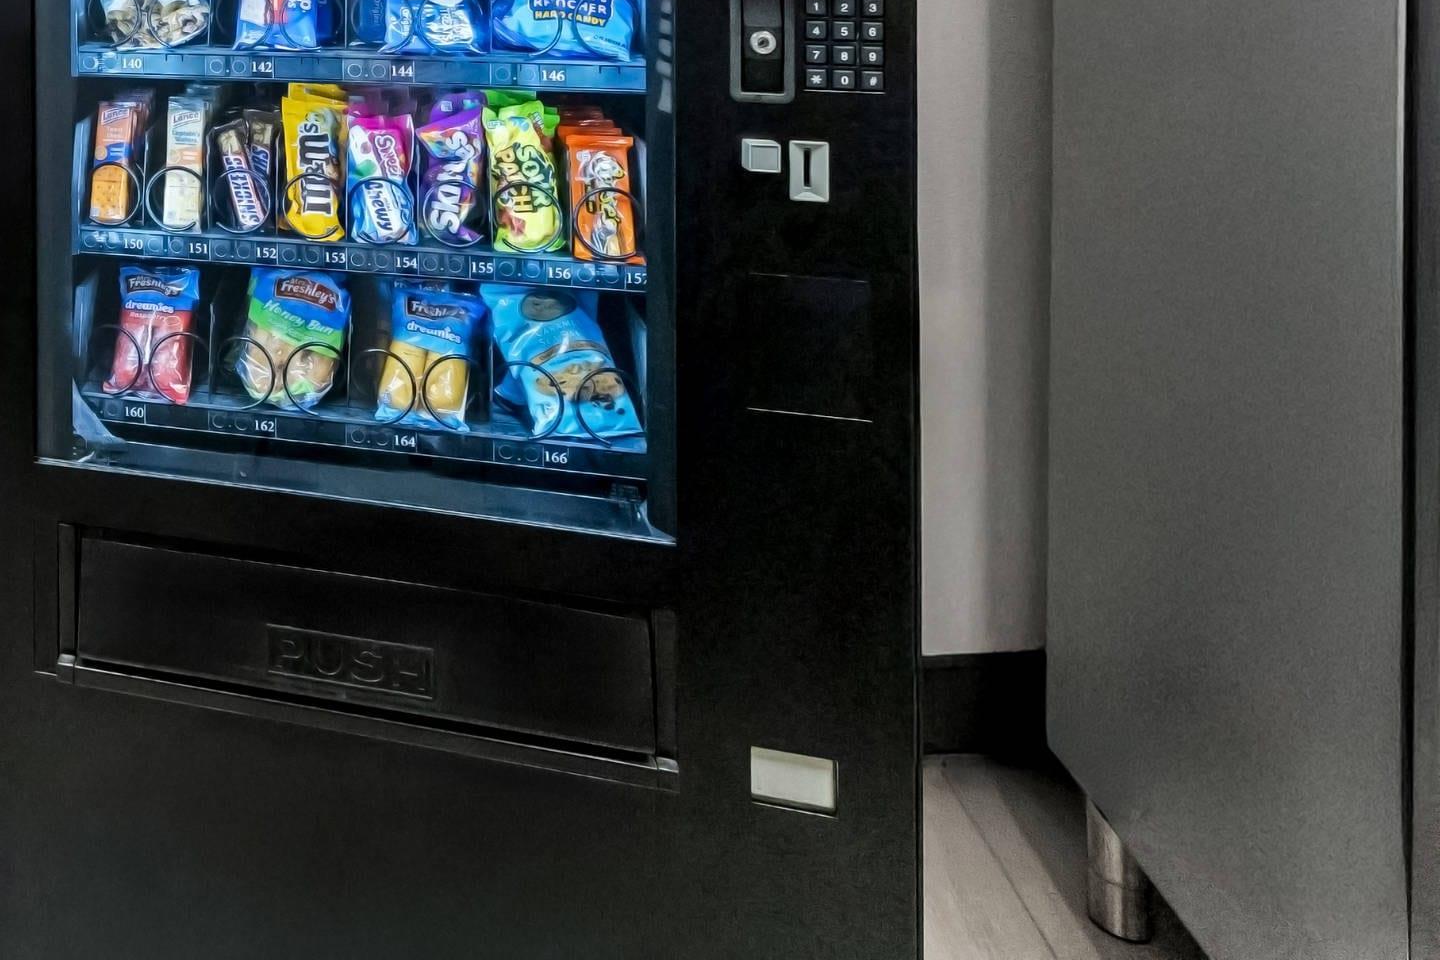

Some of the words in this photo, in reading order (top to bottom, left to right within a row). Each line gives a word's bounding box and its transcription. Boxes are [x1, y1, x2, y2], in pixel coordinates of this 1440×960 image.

[813, 2, 819, 11] 1
[840, 3, 849, 13] 2
[868, 3, 877, 13] 3
[812, 26, 821, 36] 4
[840, 27, 848, 37] 5
[868, 28, 876, 37] 6
[812, 50, 820, 60] 7
[840, 51, 848, 61] 8
[868, 52, 876, 62] 9
[122, 58, 142, 69] 140
[252, 61, 272, 72] 142
[391, 65, 413, 77] 144
[542, 70, 565, 82] 146
[840, 75, 849, 86] 0
[173, 111, 199, 123] Lance
[364, 181, 393, 231] Chewy
[124, 239, 143, 250] 150
[189, 243, 208, 254] 151
[256, 247, 277, 259] 152
[325, 252, 346, 264] 153
[395, 256, 417, 269] 154
[471, 261, 494, 273] 155
[548, 267, 571, 280] 156
[281, 280, 335, 304] Freshley's
[125, 299, 174, 313] dreamies
[263, 299, 305, 327] Honey
[307, 319, 334, 335] Bun
[407, 321, 461, 344] dreamies
[125, 406, 144, 418] 160
[254, 420, 274, 432] 162
[394, 434, 416, 447] 164
[545, 451, 568, 463] 166
[276, 638, 426, 691] PUSH
